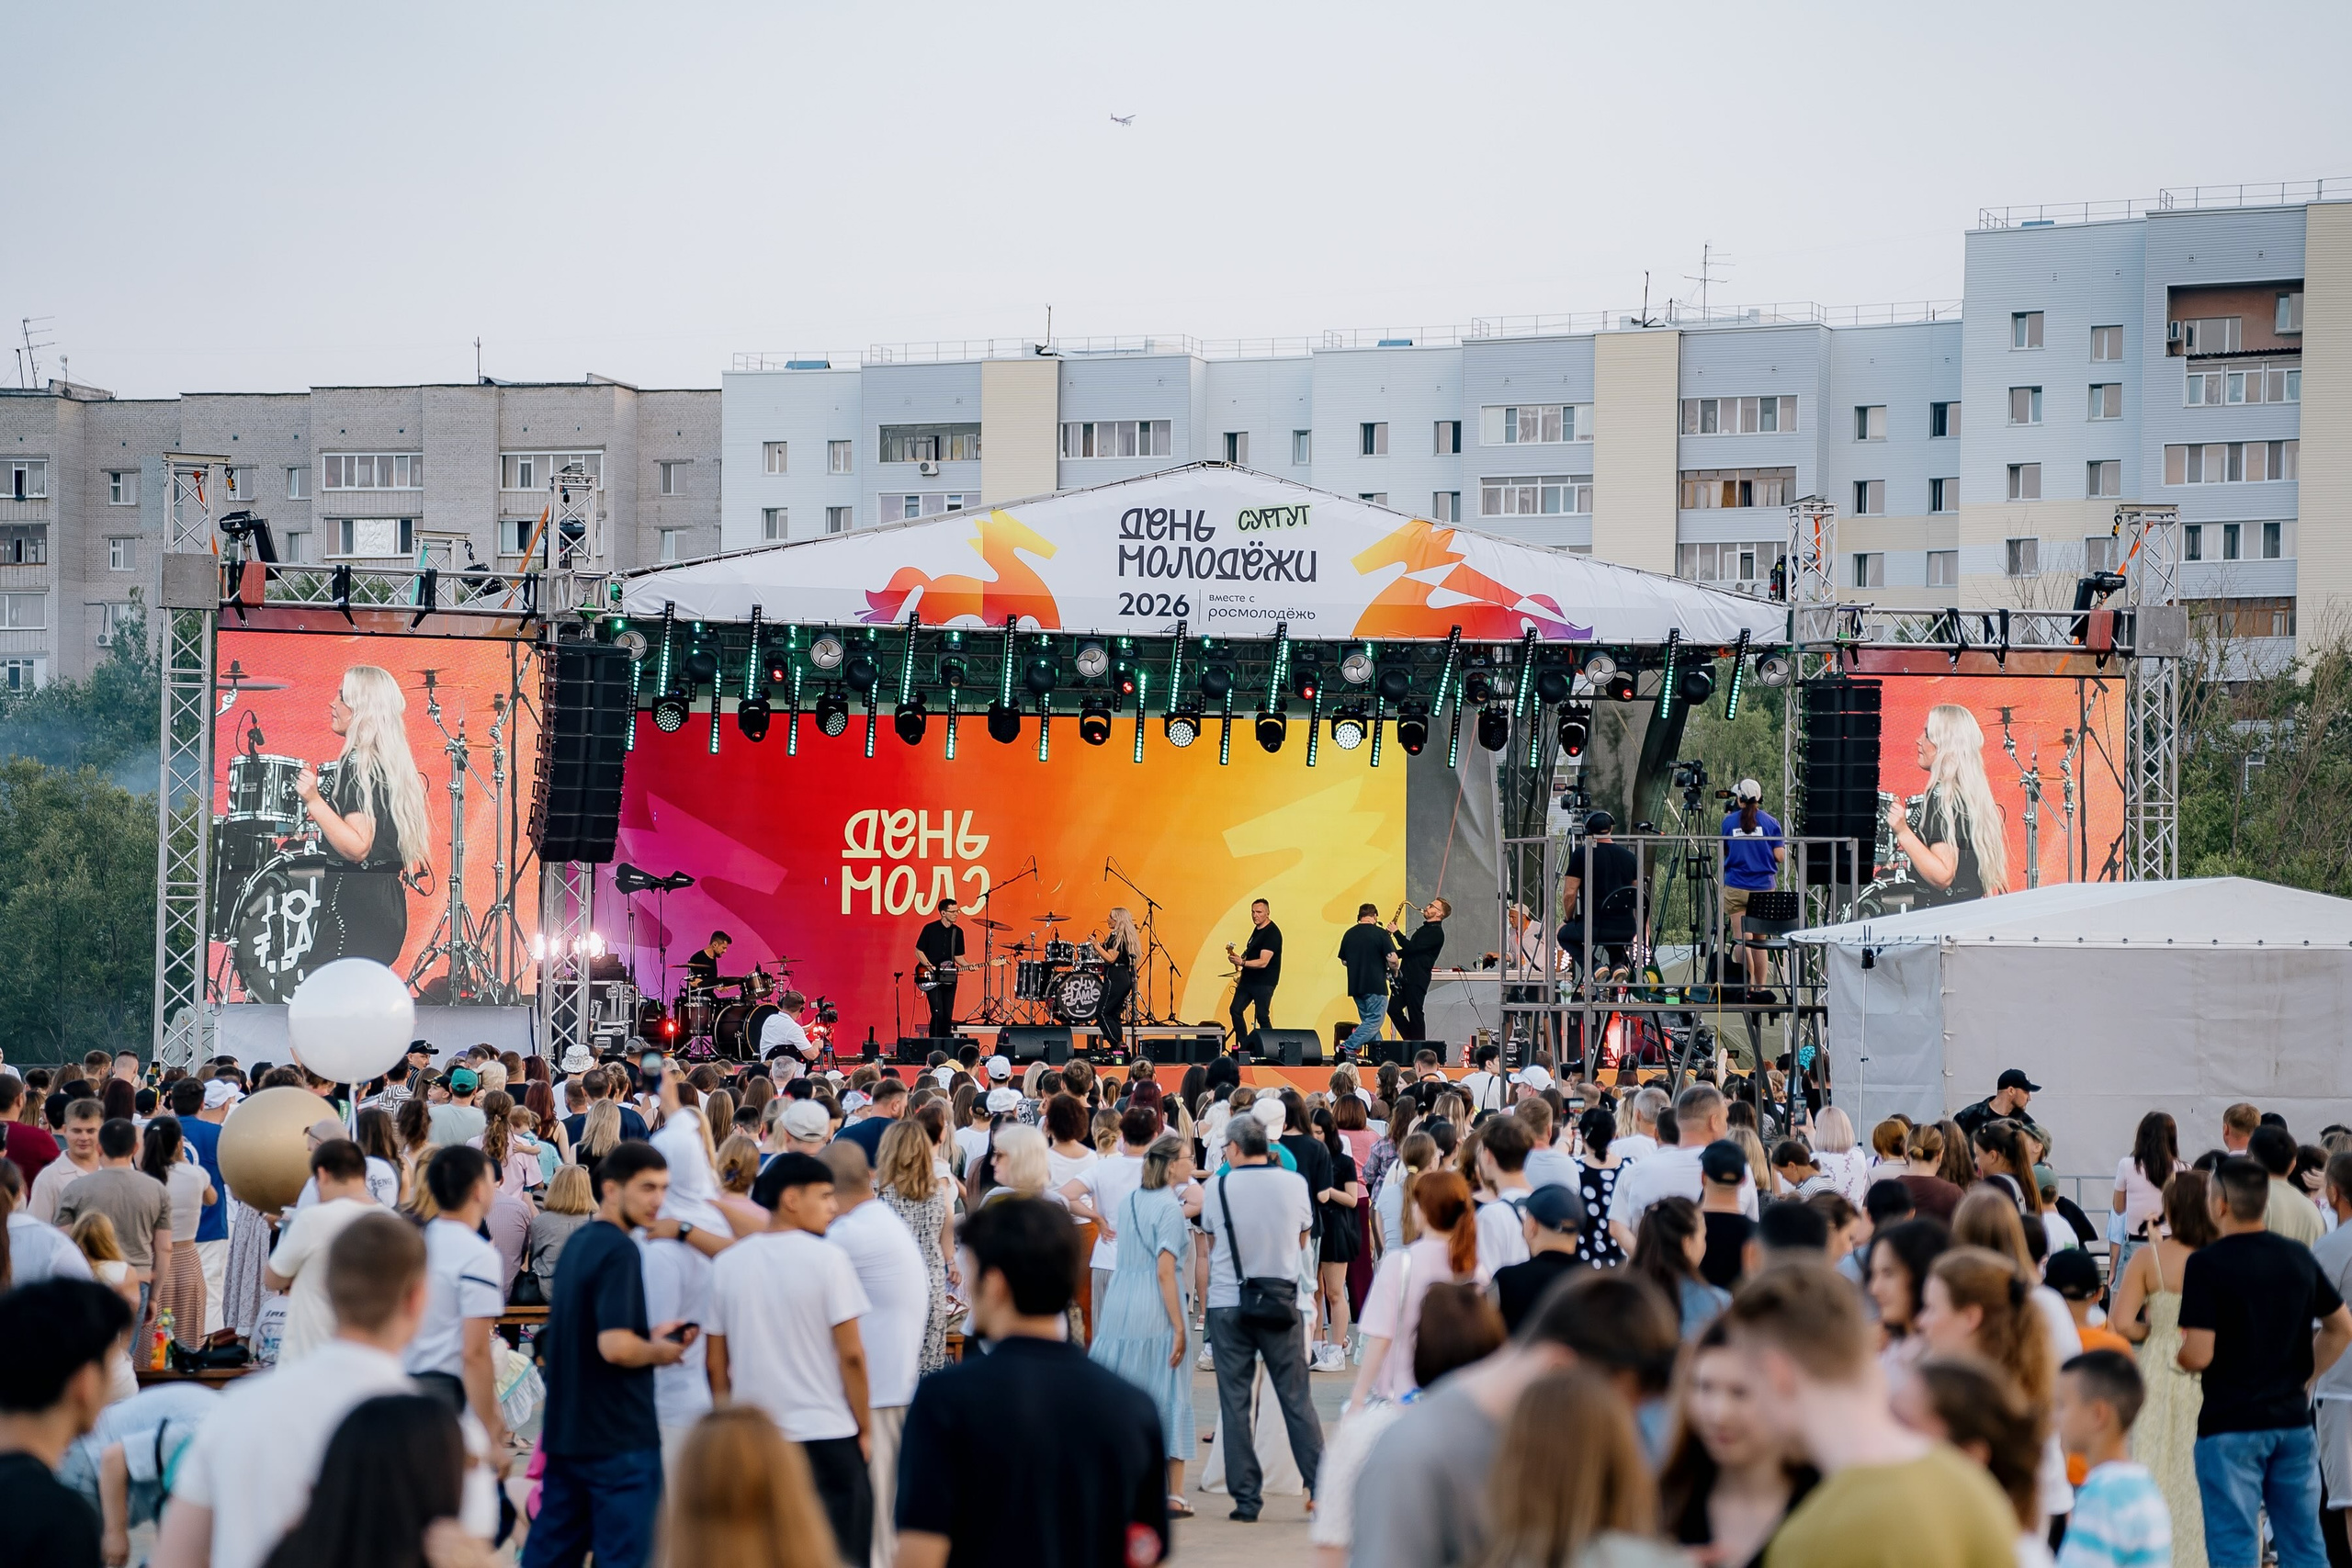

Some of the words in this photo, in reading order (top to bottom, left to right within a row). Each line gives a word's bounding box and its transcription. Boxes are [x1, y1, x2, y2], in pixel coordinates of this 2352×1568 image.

[1238, 504, 1310, 531] СУРГУТ
[1118, 592, 1191, 617] 2026
[1209, 593, 1246, 603] вместе
[1208, 607, 1316, 622] росмолодёжь
